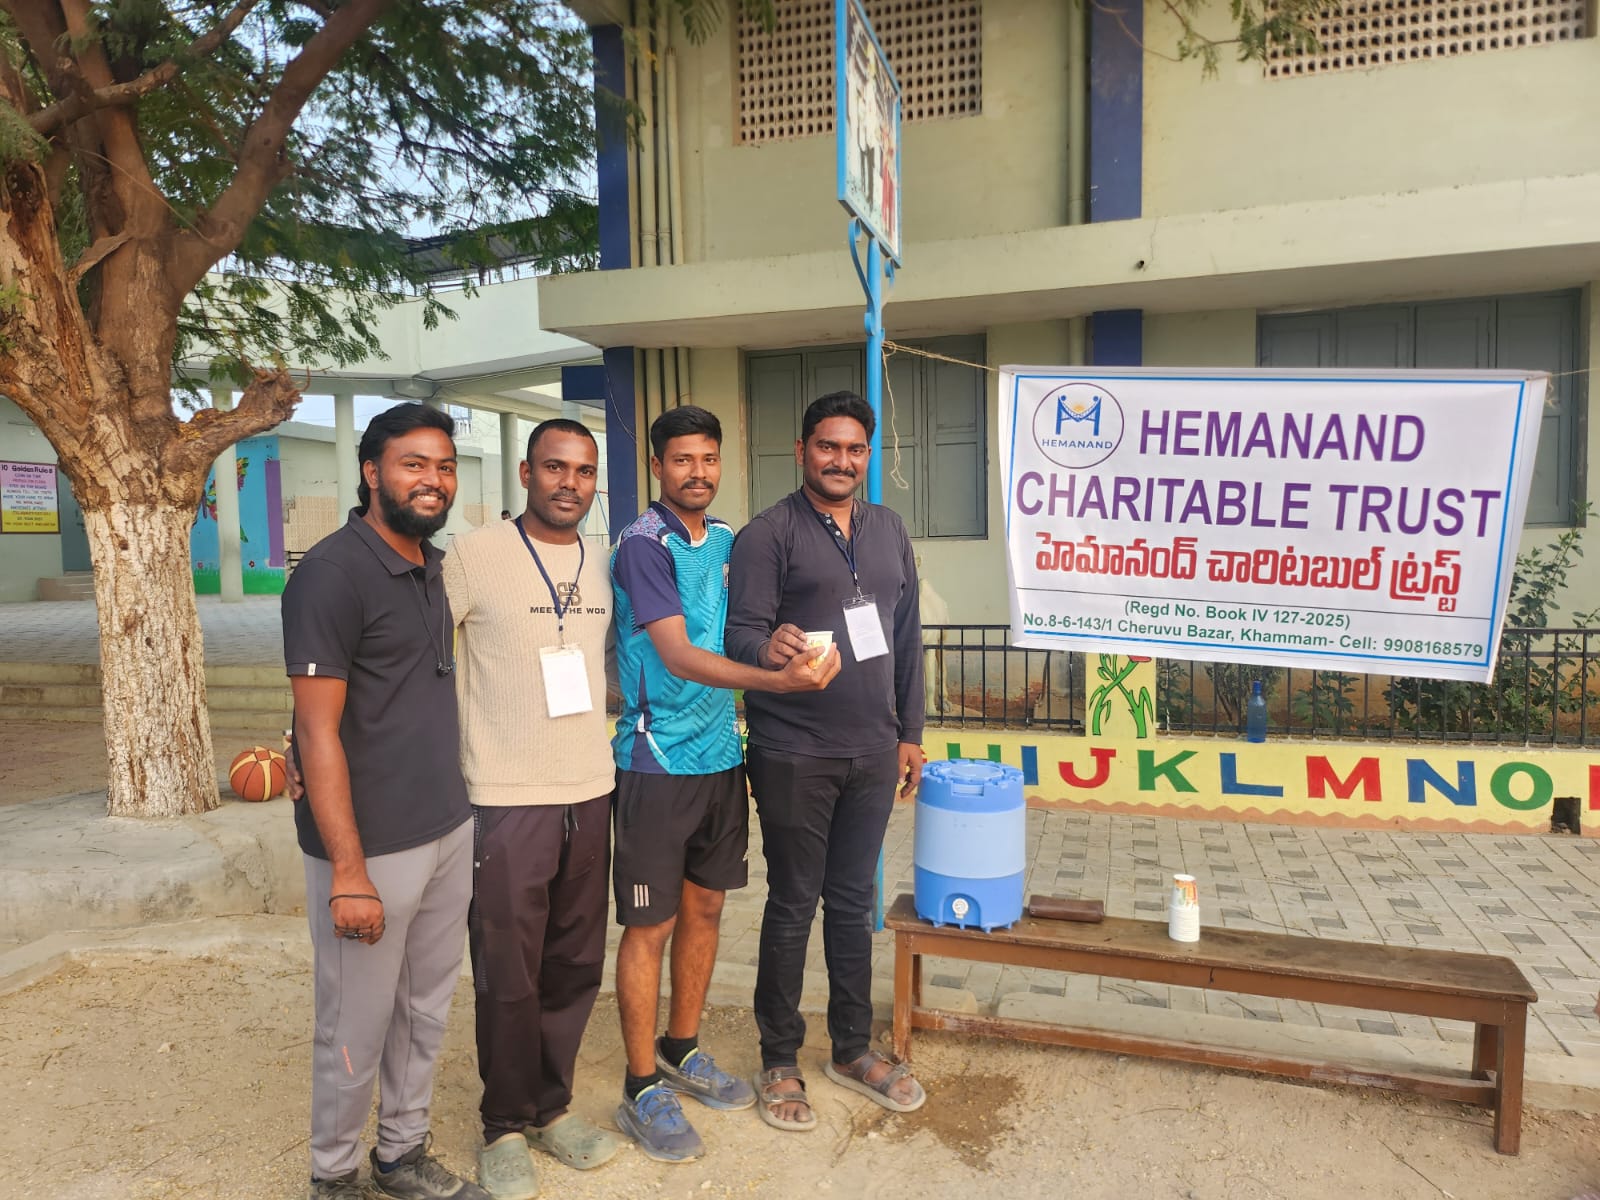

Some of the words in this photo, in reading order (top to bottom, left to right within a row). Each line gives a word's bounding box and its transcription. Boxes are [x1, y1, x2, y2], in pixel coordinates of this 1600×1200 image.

[1041, 438, 1113, 449] HEMANAND
[1139, 409, 1426, 462] HEMANAND
[1016, 471, 1312, 529] CHARITABLE
[1329, 484, 1502, 538] TRUST
[1023, 612, 1113, 632] No.8-6-143/1
[1118, 619, 1182, 637] Cheruvu
[1187, 624, 1235, 642] Bazar,
[1241, 628, 1335, 647] Khammam-
[1339, 634, 1378, 651] Cell:
[1383, 638, 1484, 658] 9908168579
[1125, 600, 1170, 618] (Regd
[1174, 603, 1200, 618] No.
[1206, 606, 1247, 621] Book
[1252, 609, 1269, 621] IV
[1273, 610, 1351, 630] 127-2025)
[1058, 747, 1117, 789] J
[1137, 749, 1199, 793] K
[1219, 752, 1284, 798] L
[1306, 755, 1383, 802] M
[1406, 758, 1477, 807] N
[1490, 761, 1554, 811] O
